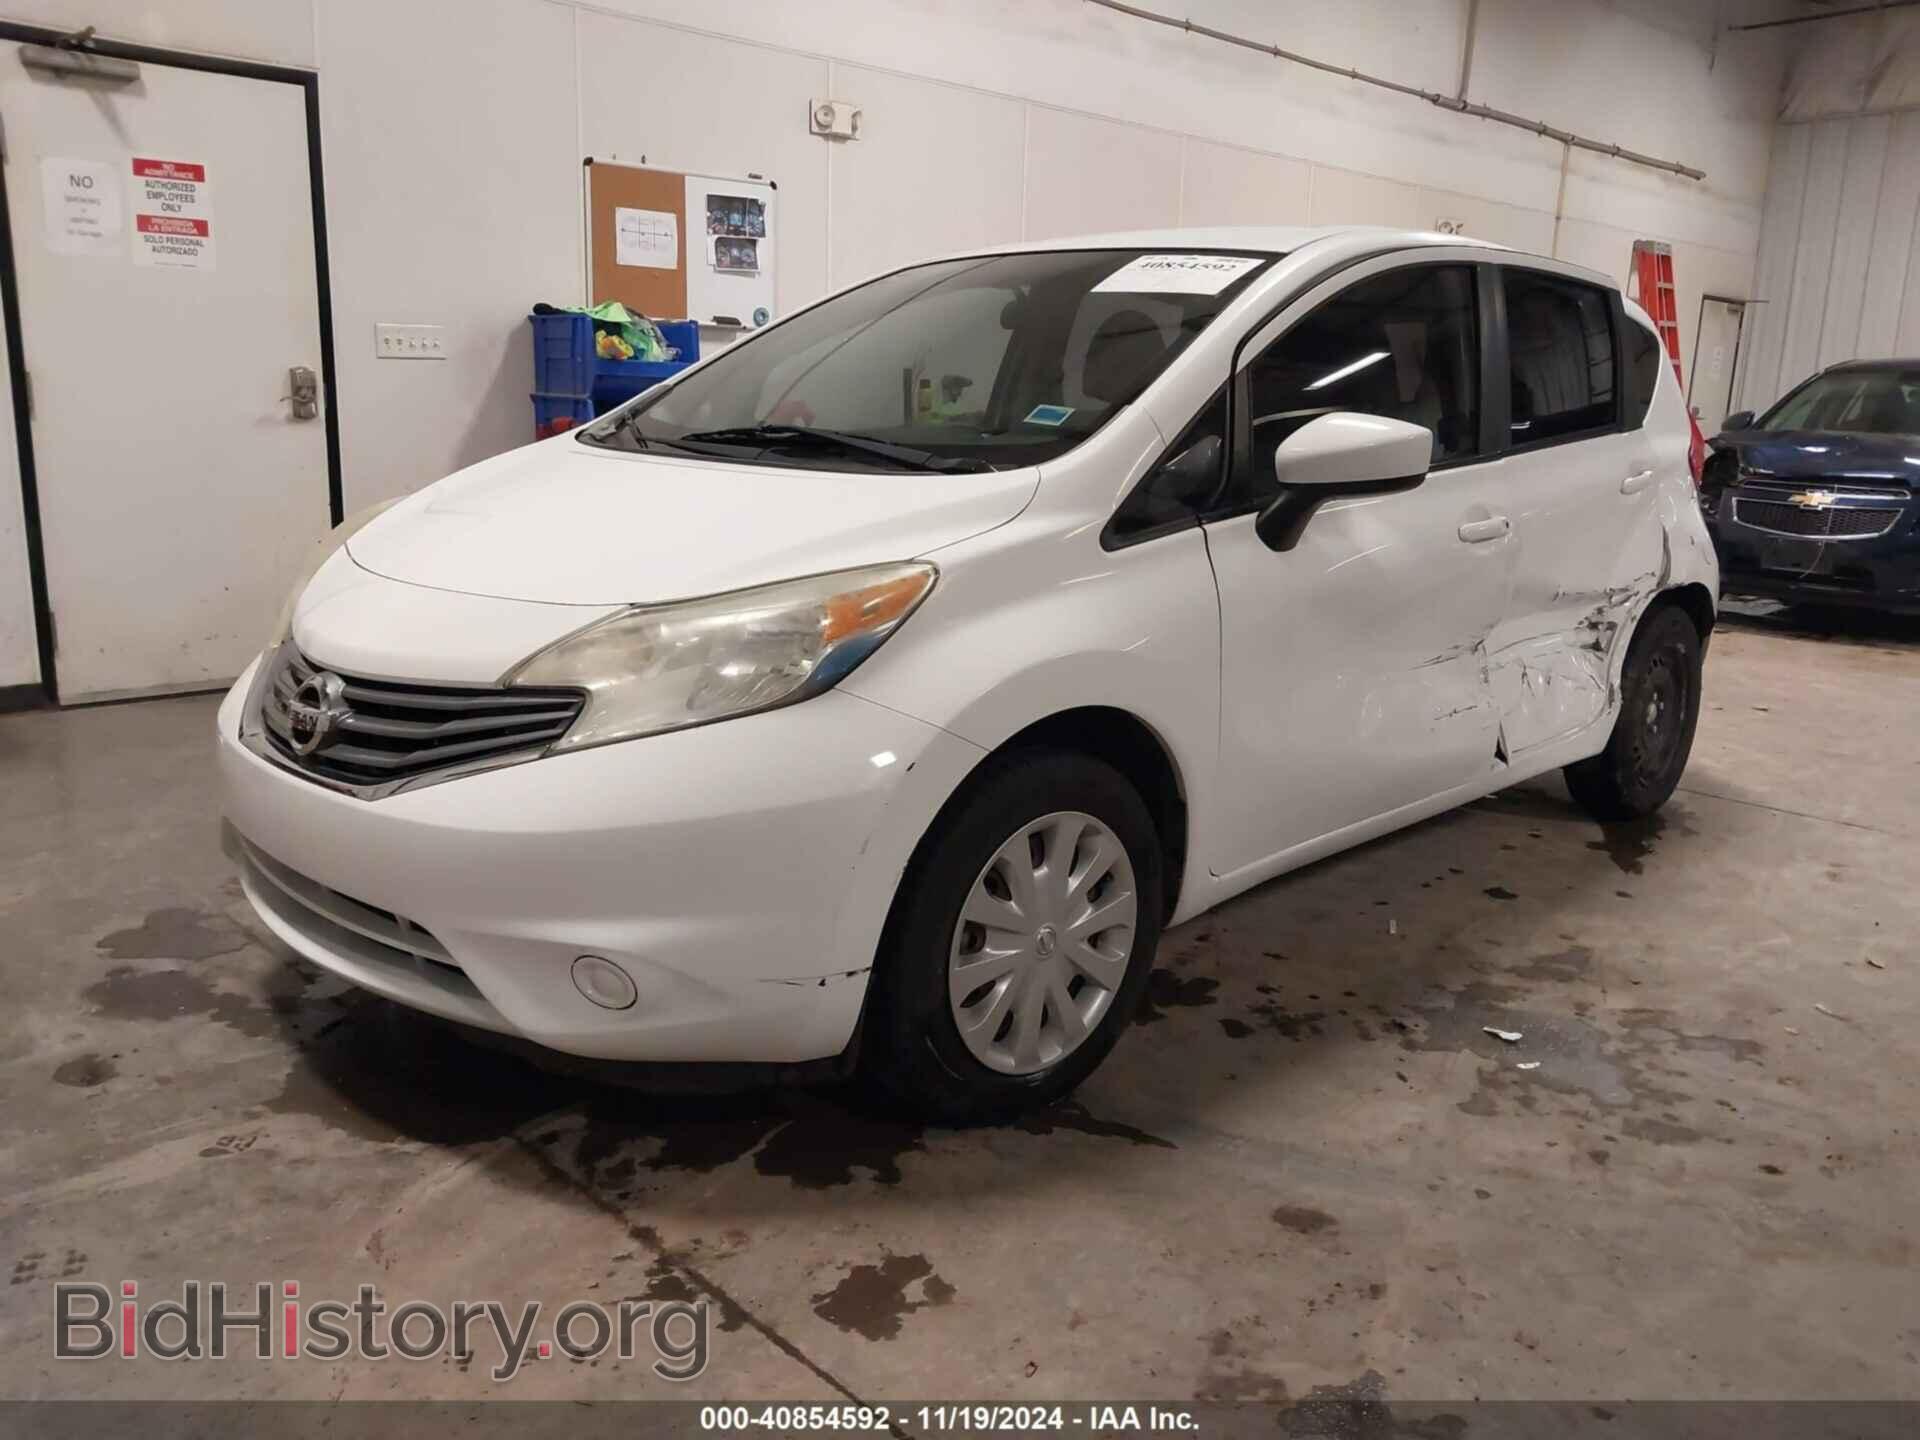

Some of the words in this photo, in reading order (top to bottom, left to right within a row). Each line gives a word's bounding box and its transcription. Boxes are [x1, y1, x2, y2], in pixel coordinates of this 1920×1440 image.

[69, 174, 94, 189] NO
[145, 180, 196, 193] AUTHORIZED
[146, 191, 196, 204] EMPLOYEES
[161, 202, 182, 212] ONLY
[144, 234, 164, 244] SOLO
[165, 236, 205, 248] PERSONAL
[152, 245, 199, 257] AUTORIZADO
